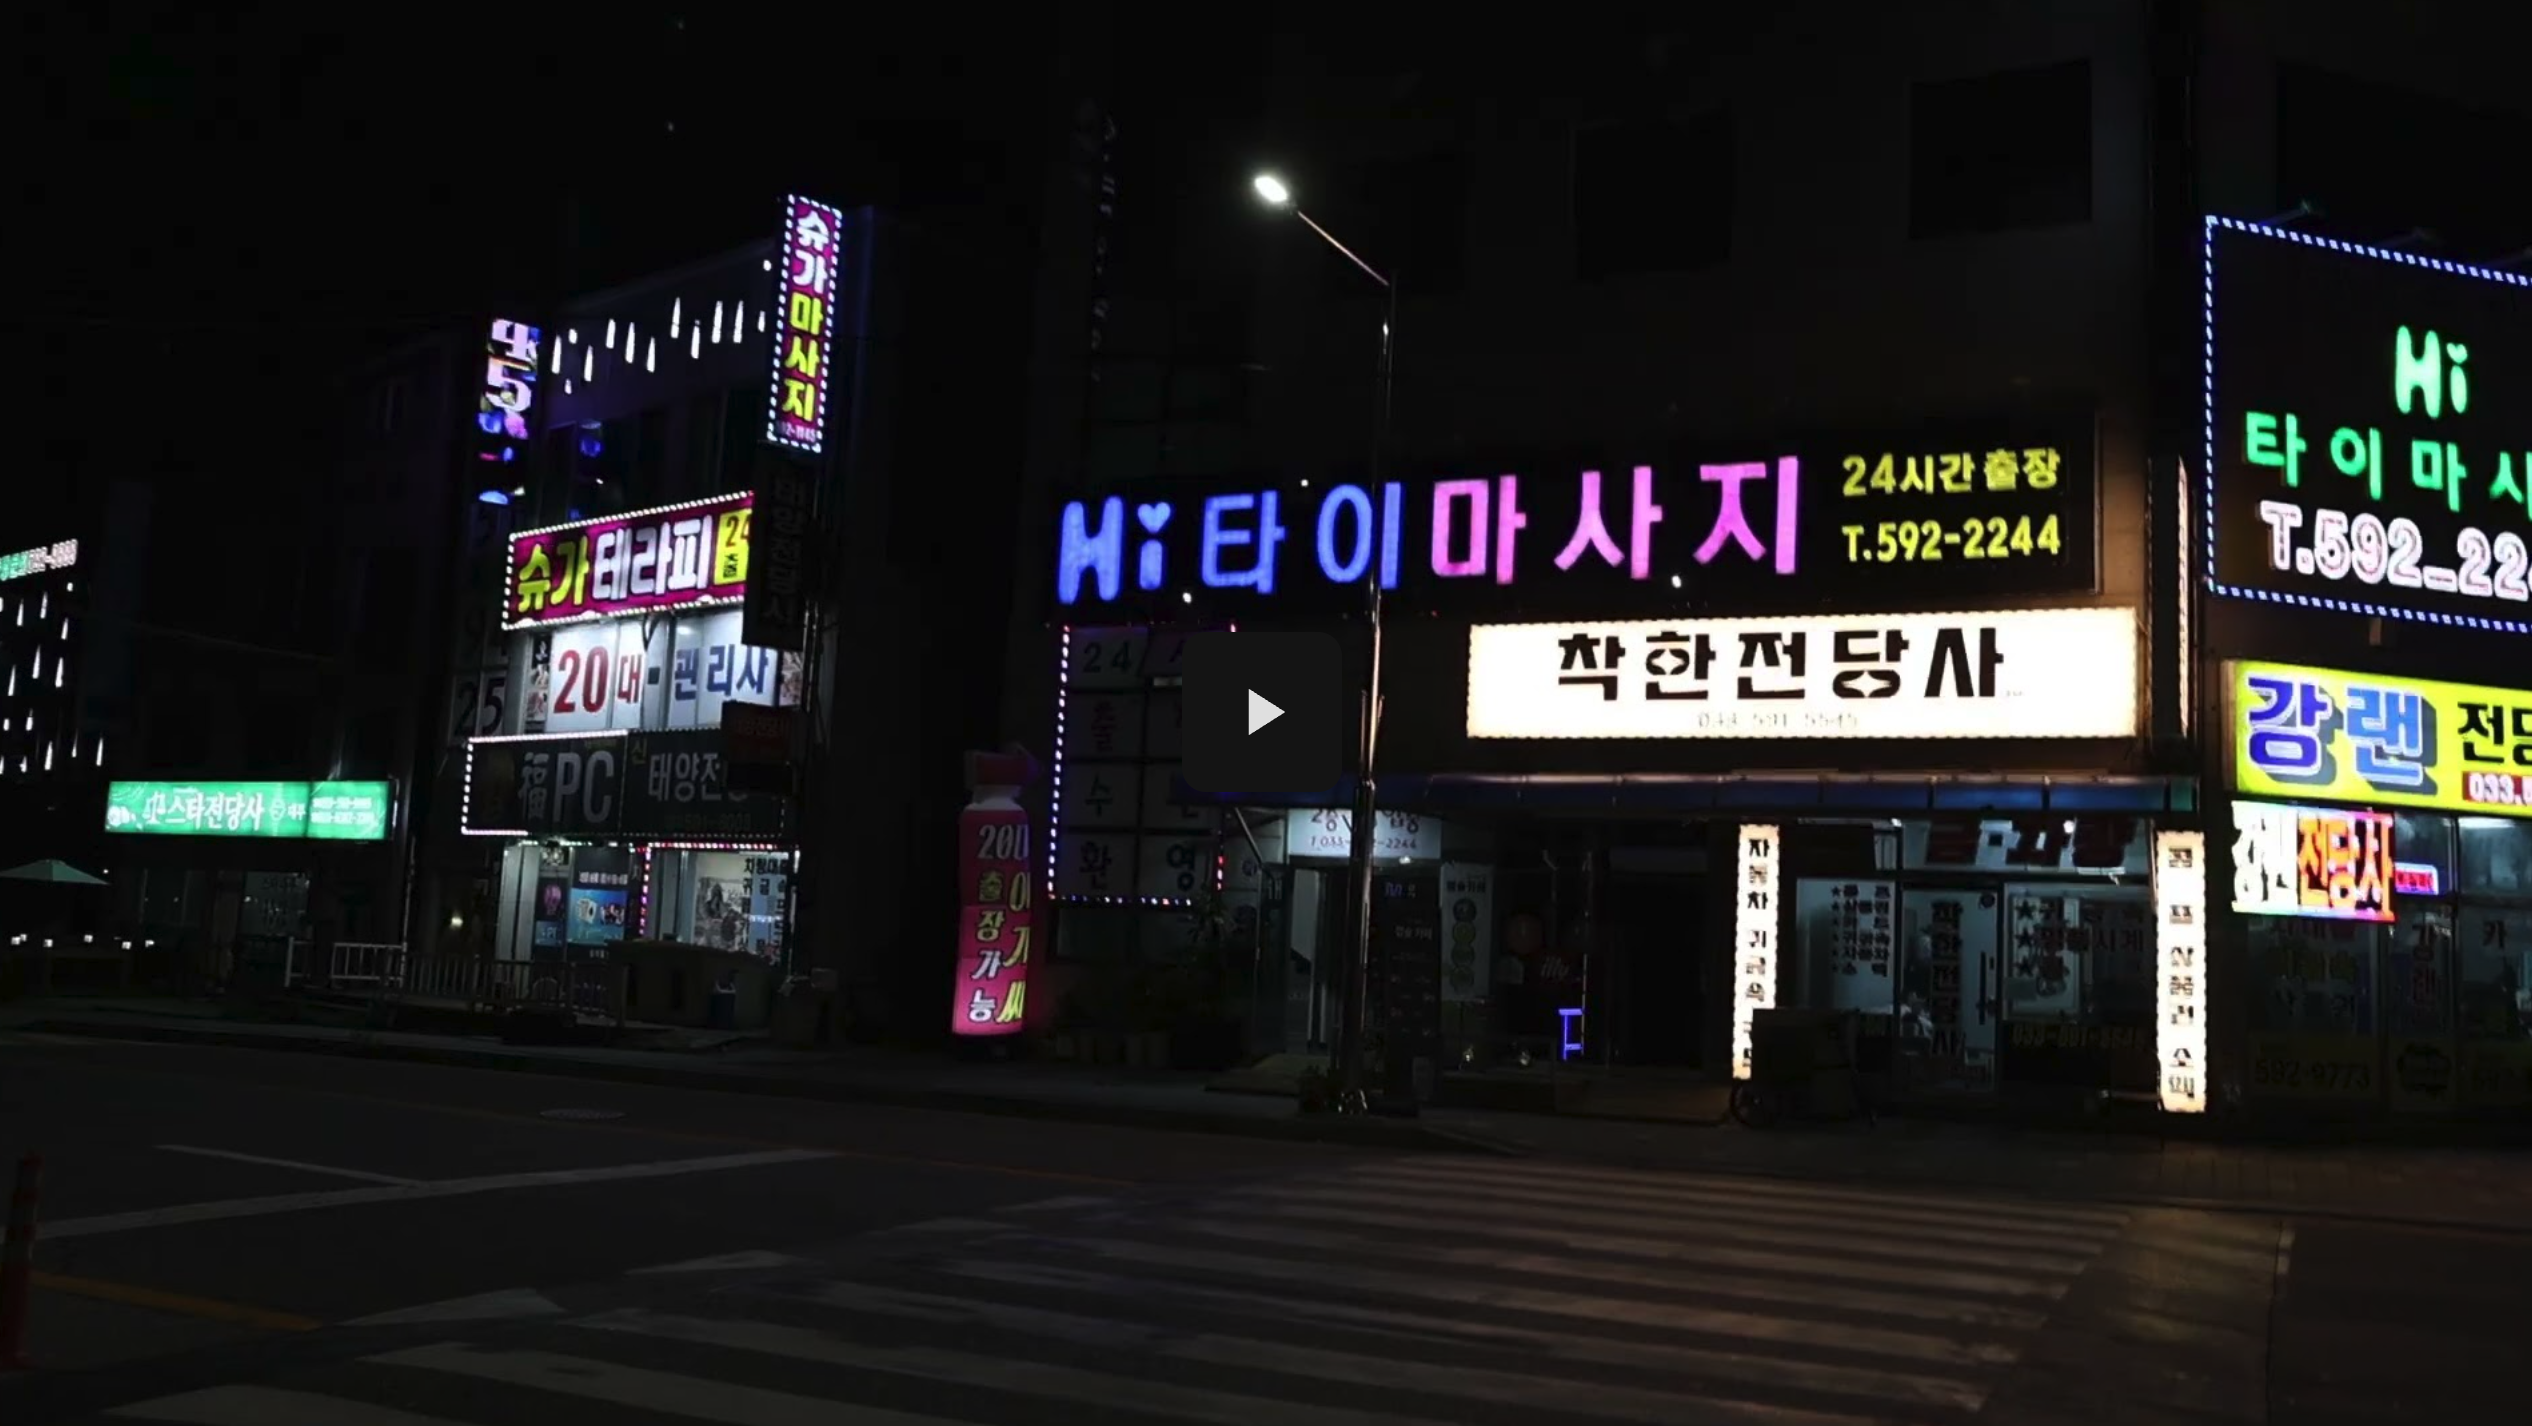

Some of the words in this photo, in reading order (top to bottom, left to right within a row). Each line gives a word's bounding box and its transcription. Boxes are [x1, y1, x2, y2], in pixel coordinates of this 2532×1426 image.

[783, 211, 831, 422] 슈가마사지
[2394, 324, 2469, 419] Hi
[1983, 447, 2061, 491] 출장
[517, 514, 713, 613] 슈가테라피
[1842, 514, 2061, 562] T.592-2244
[553, 646, 643, 716] 20대
[1557, 626, 2004, 701] 착한전당사
[2246, 674, 2430, 789] 강랜
[967, 870, 1005, 1024] 출장가능
